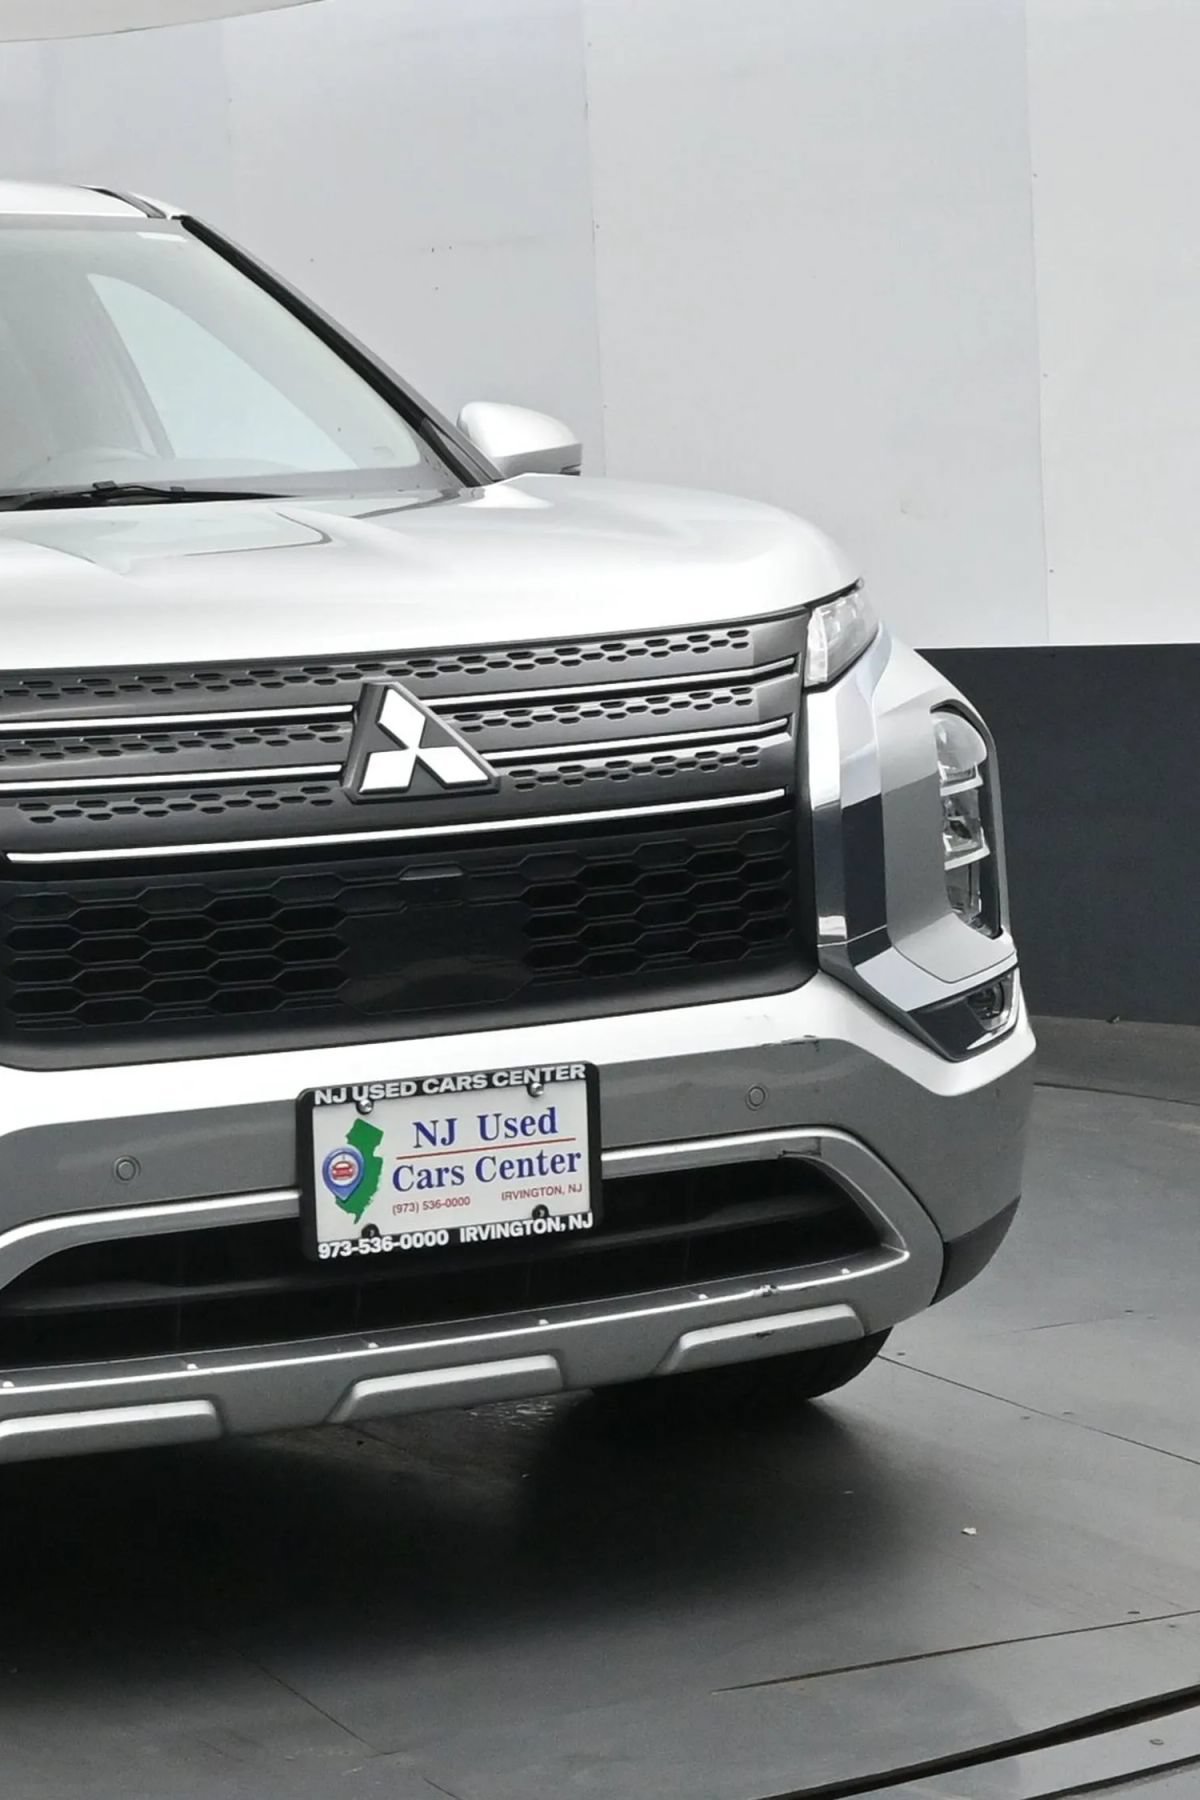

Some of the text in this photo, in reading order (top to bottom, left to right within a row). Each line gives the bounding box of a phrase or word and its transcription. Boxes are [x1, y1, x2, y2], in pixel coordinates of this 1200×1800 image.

[315, 1064, 585, 1105] NJ USED CARS CENTER
[413, 1107, 558, 1148] NJ Used
[393, 1150, 582, 1192] Cars Center
[392, 1196, 471, 1216] (973) 536-0000
[502, 1184, 582, 1202] IRVINGTON, NJ
[460, 1212, 593, 1244] IRVINGTON, NJ
[318, 1230, 449, 1259] 973-536-0000
